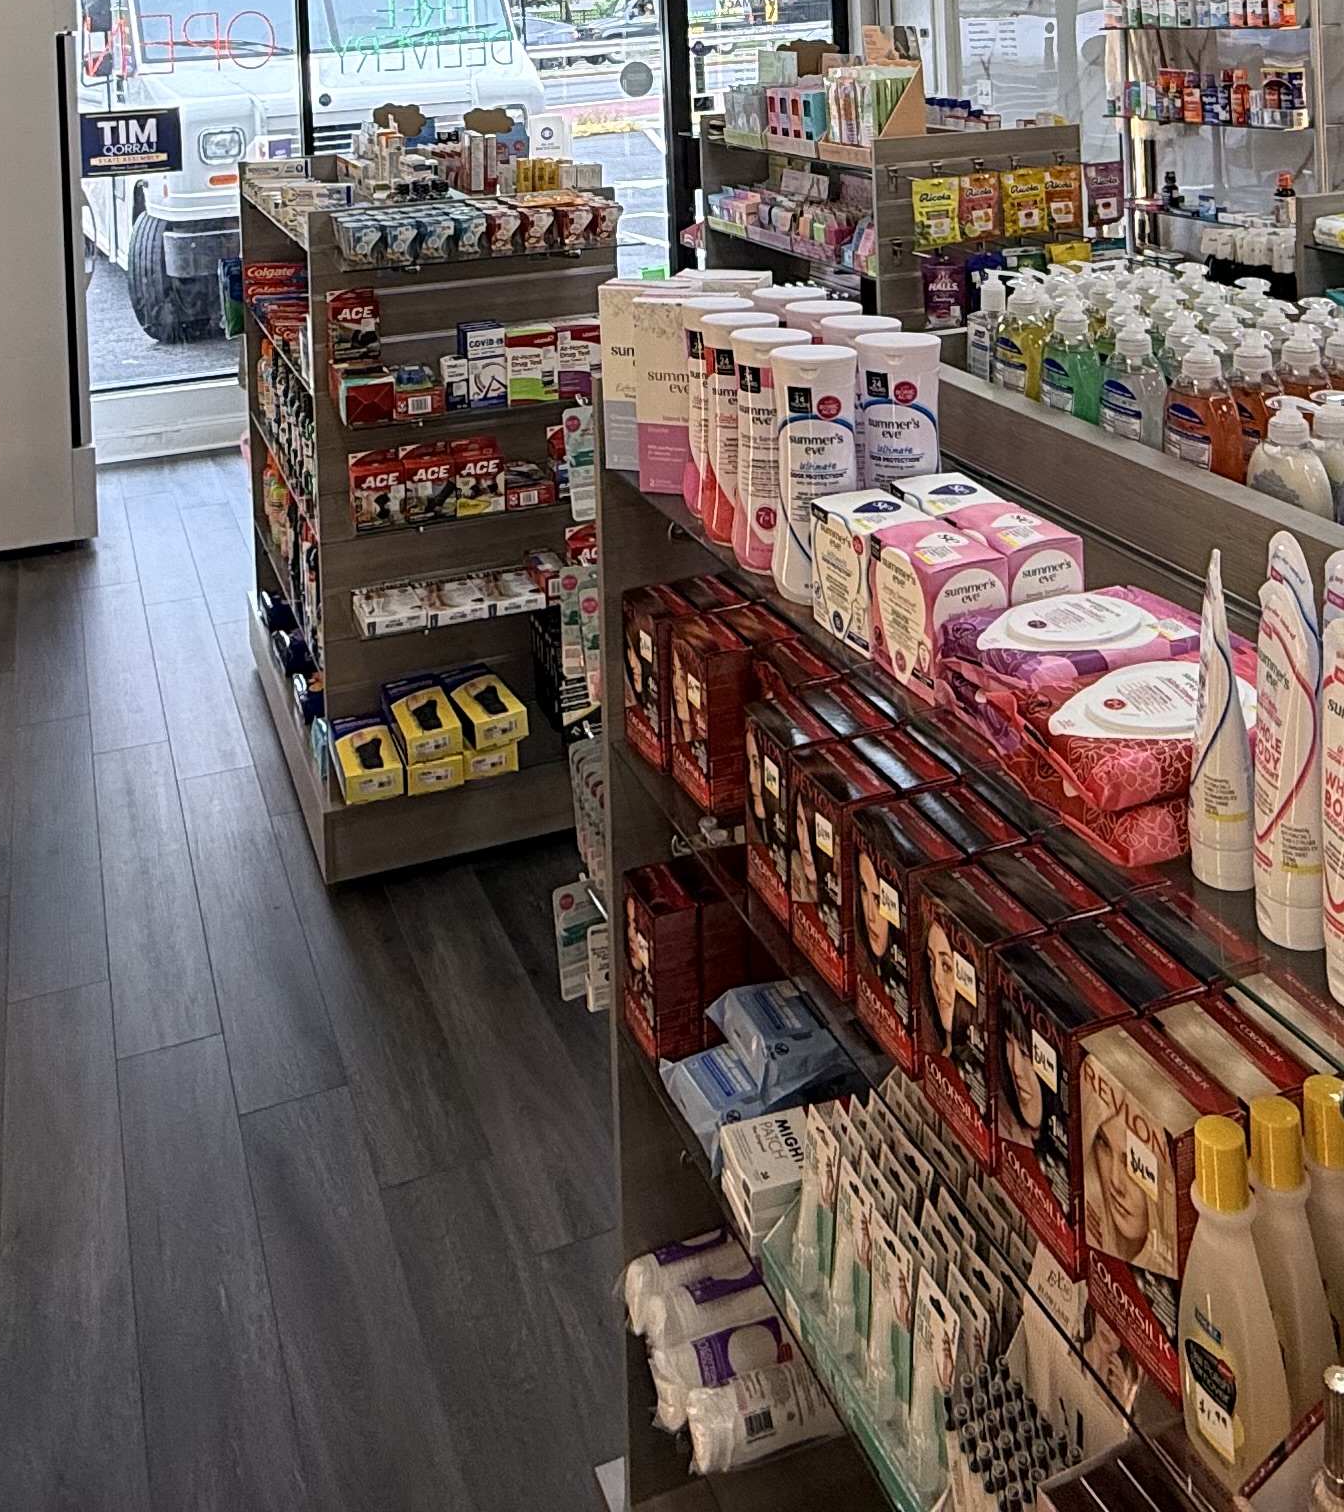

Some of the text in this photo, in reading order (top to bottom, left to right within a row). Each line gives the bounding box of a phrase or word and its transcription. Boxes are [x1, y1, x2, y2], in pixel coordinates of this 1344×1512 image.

[97, 118, 158, 145] TIM
[103, 144, 157, 156] QORRAJ
[1045, 180, 1073, 190] Ricola
[1091, 177, 1118, 186] Ricola
[965, 188, 992, 197] Ricola
[1010, 184, 1039, 195] Ricola
[919, 192, 951, 202] Ricola
[246, 266, 296, 278] Colgate
[928, 282, 958, 292] HALLS
[338, 305, 374, 320] ACE
[468, 337, 504, 349] COVID-19
[559, 343, 591, 354] At-Home
[511, 352, 542, 363] At-Home
[559, 349, 591, 360] Drug Test
[511, 359, 542, 370] Drug Test
[868, 417, 920, 430] summer's
[789, 433, 844, 444] summer's
[882, 430, 902, 439] eve
[805, 446, 825, 456] eve
[412, 465, 450, 482] ACE
[462, 459, 500, 476] ACE
[361, 472, 400, 489] ACE
[820, 522, 852, 548] summer's
[829, 539, 843, 552] eve
[881, 558, 917, 587] summer's
[1022, 559, 1072, 578] summer's
[892, 574, 907, 588] eve
[1038, 572, 1058, 585] eve
[944, 580, 996, 598] summer's
[961, 592, 981, 604] eve
[857, 974, 906, 1043] COLORSILK
[925, 1054, 984, 1133] COLORSILK
[1083, 1057, 1168, 1162] REVLON
[759, 1121, 787, 1161] PATCH
[1000, 1140, 1070, 1236] COLORSILK
[1088, 1249, 1174, 1360] COLORSILK
